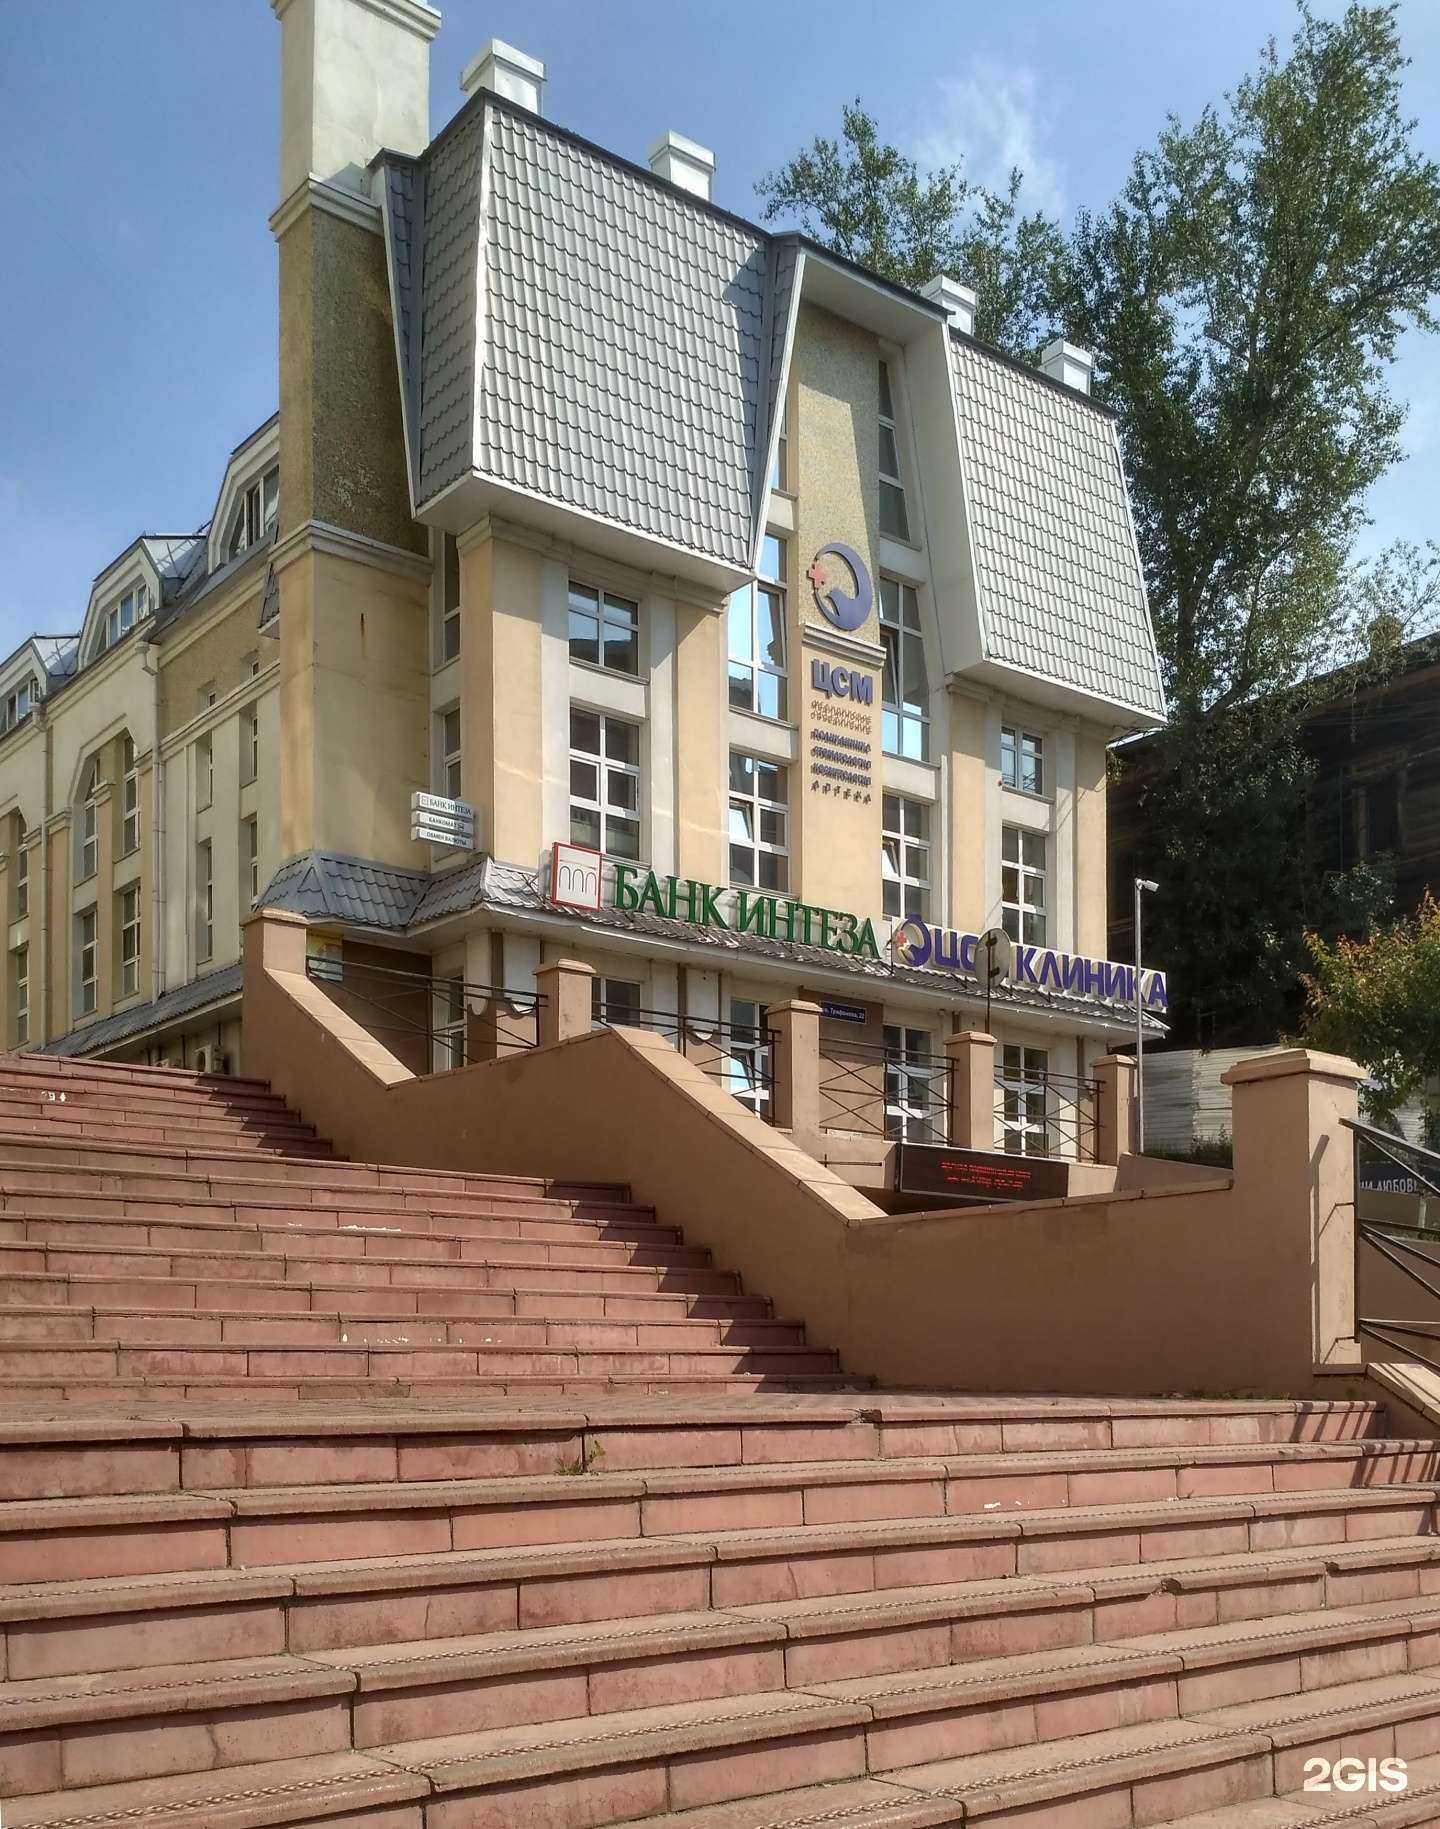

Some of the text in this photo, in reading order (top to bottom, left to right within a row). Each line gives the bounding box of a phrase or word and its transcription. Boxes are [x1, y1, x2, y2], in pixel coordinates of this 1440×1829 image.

[811, 658, 873, 705] ЦСМ
[612, 863, 882, 960] БАНК ИНТЕЗА
[934, 928, 1169, 1008] ЦС КЛИНИКА
